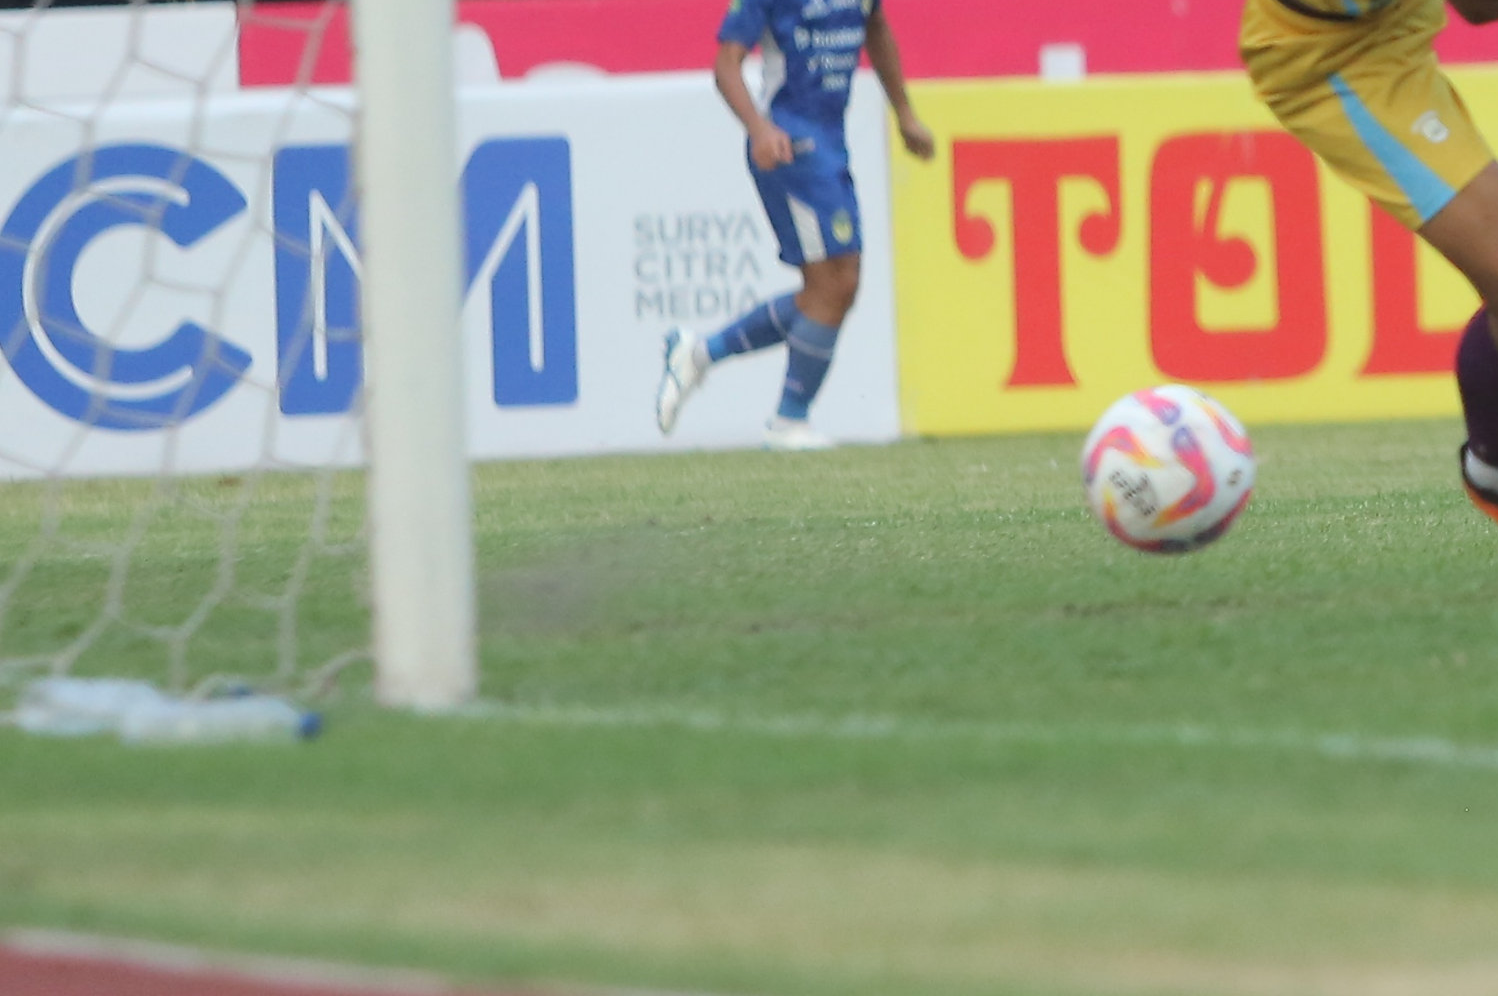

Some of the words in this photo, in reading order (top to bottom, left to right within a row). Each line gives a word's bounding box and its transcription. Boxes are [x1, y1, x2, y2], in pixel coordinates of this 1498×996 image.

[633, 212, 761, 247] SURYA
[633, 252, 763, 283] CITRA
[635, 285, 761, 321] MEDIA
